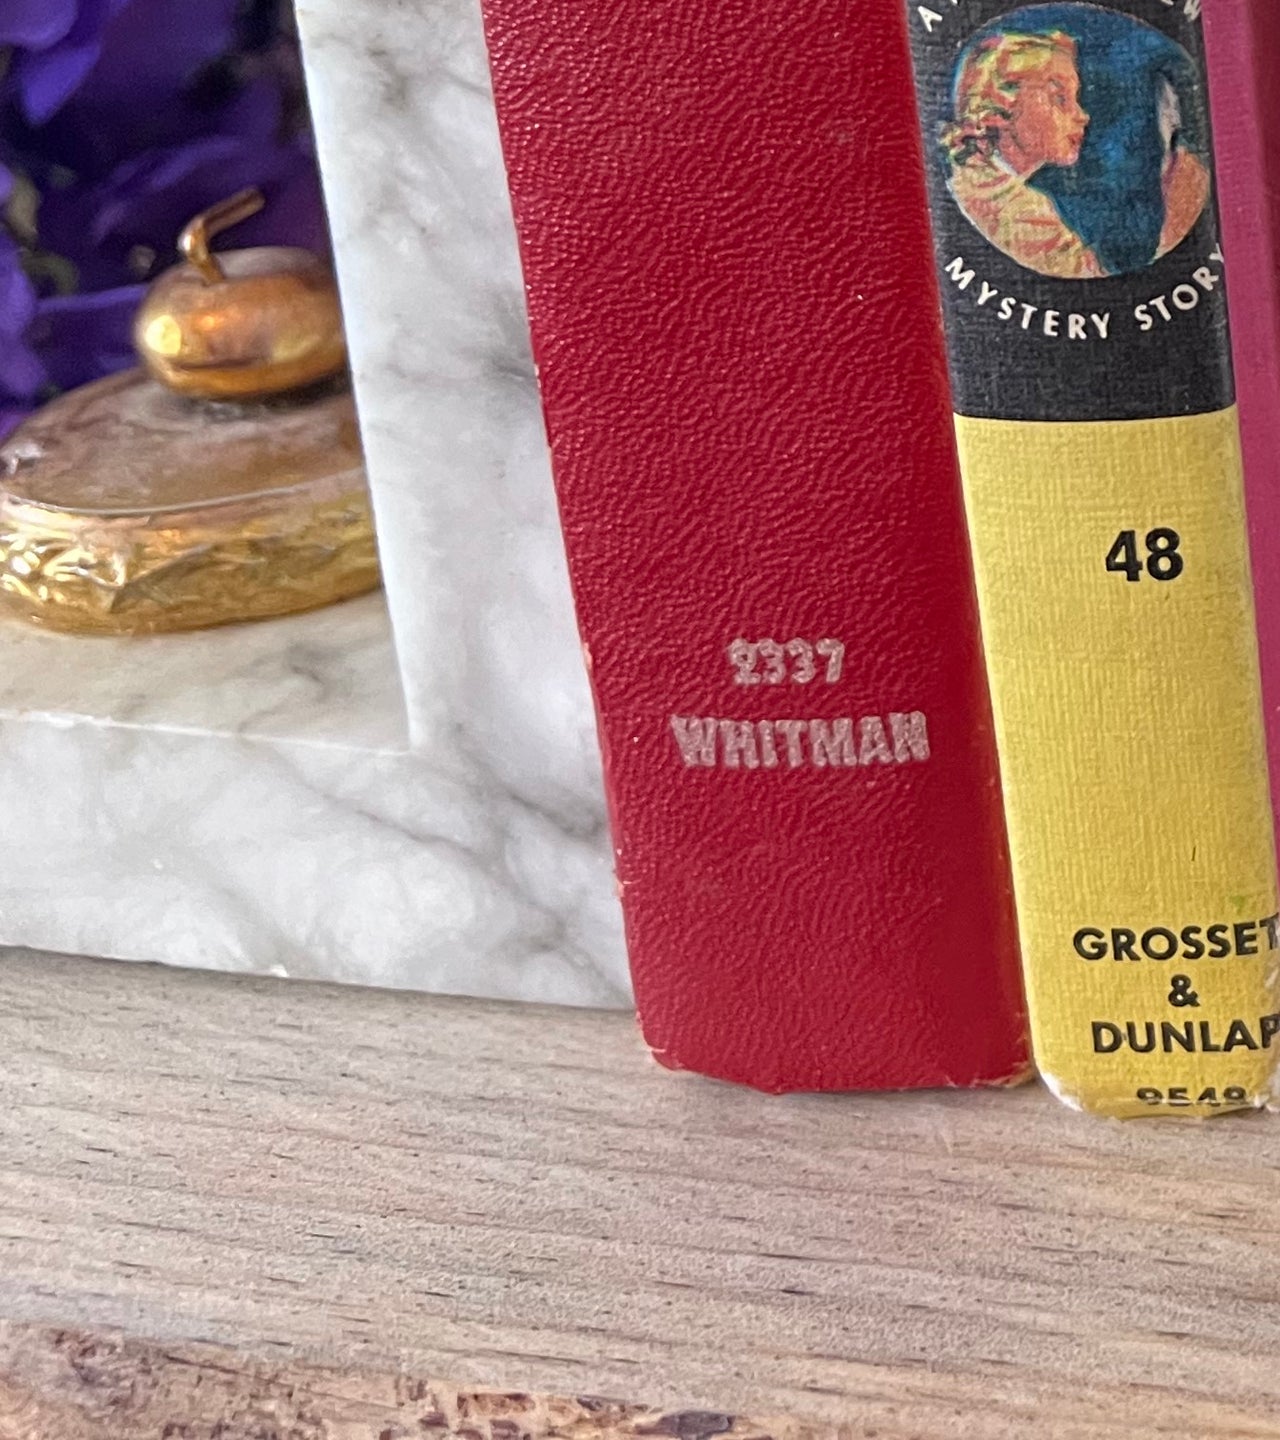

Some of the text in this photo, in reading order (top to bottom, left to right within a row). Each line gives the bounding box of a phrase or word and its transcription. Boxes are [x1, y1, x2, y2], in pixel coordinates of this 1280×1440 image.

[915, 6, 943, 32] A
[944, 242, 1224, 340] MYSTERY STORY
[1105, 528, 1184, 582] 48
[727, 638, 845, 684] 2337
[669, 710, 931, 769] WHITMAN
[1073, 912, 1280, 961] GROSSET
[1168, 974, 1201, 1007] &
